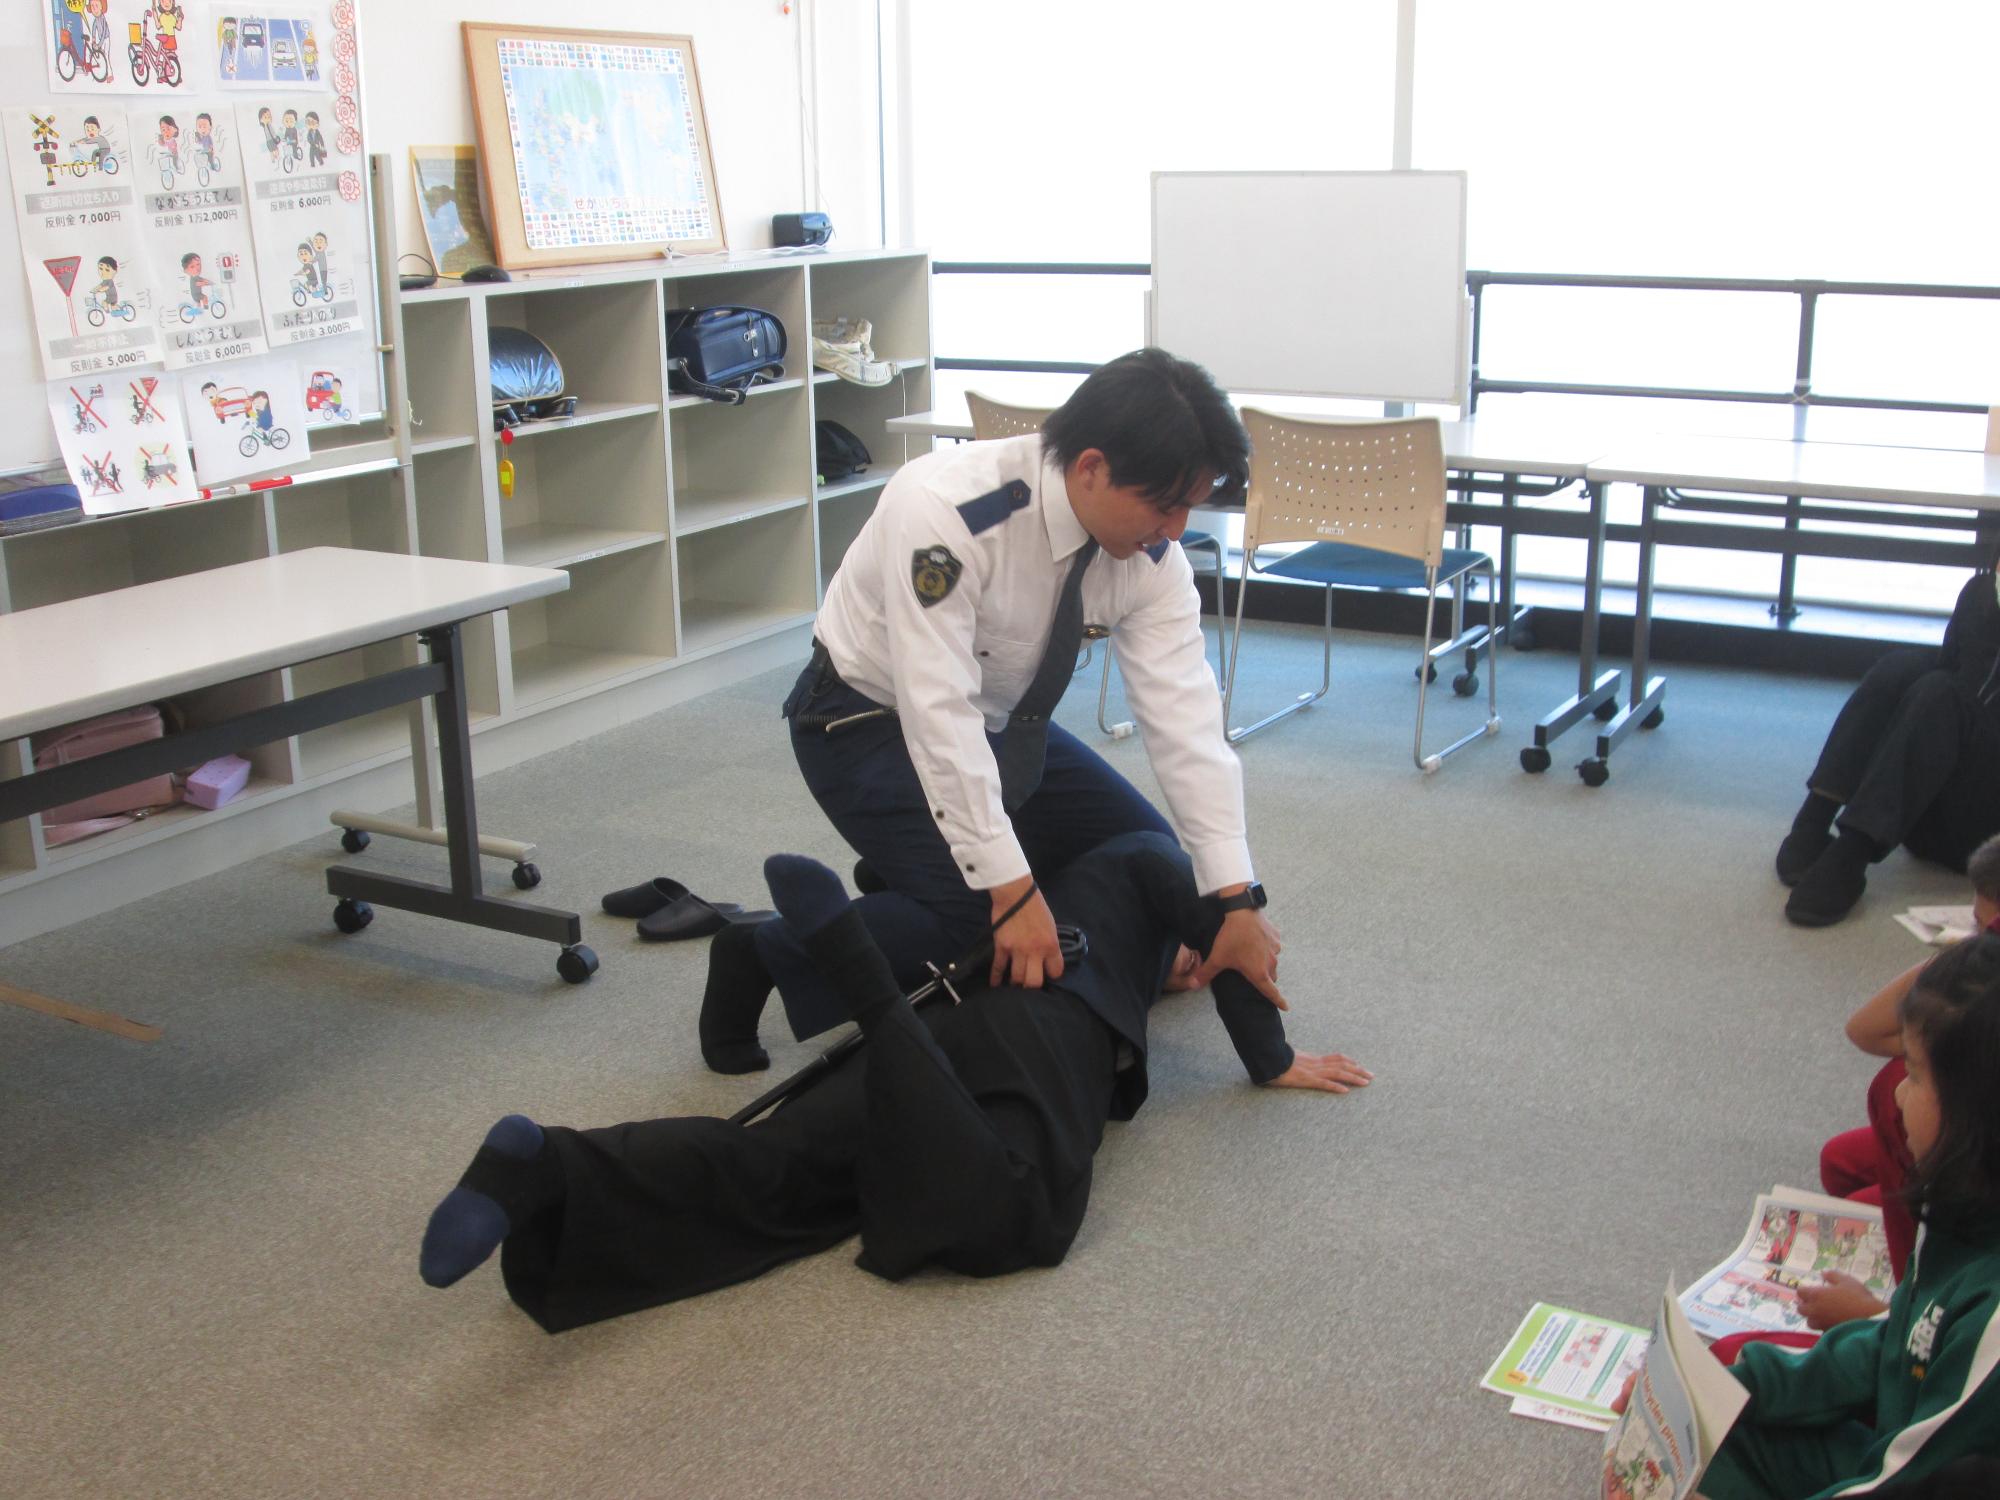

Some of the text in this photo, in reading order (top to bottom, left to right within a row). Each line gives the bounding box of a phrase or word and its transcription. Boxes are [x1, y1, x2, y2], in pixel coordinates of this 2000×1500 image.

[155, 188, 233, 210] ながらうんてん
[270, 195, 331, 212] 反則金 6,000円
[46, 213, 75, 228] 反則金
[155, 209, 238, 228] 反則金 1万2,000円
[283, 308, 336, 327] ふたりのり
[215, 343, 251, 358] 6,000円
[71, 350, 146, 373] 反則金 5,000円
